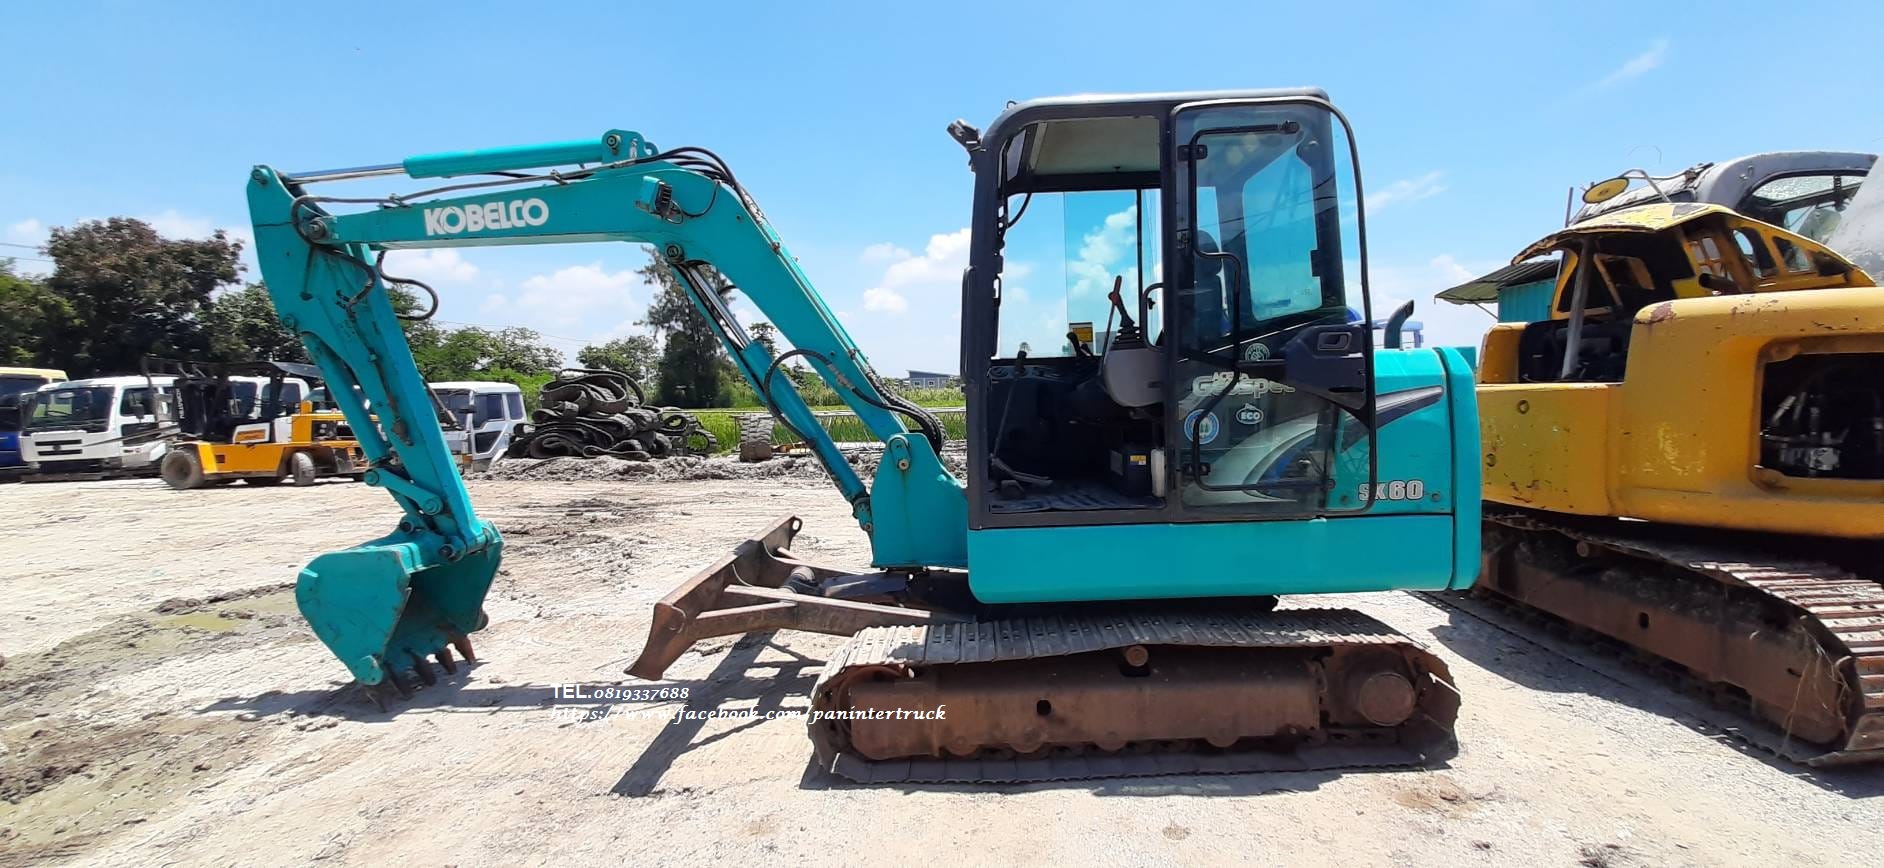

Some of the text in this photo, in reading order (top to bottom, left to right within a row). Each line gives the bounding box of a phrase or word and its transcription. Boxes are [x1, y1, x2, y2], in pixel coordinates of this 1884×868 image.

[424, 198, 549, 236] KOBELCO
[1240, 411, 1261, 421] ECO
[1358, 480, 1424, 501] SK60
